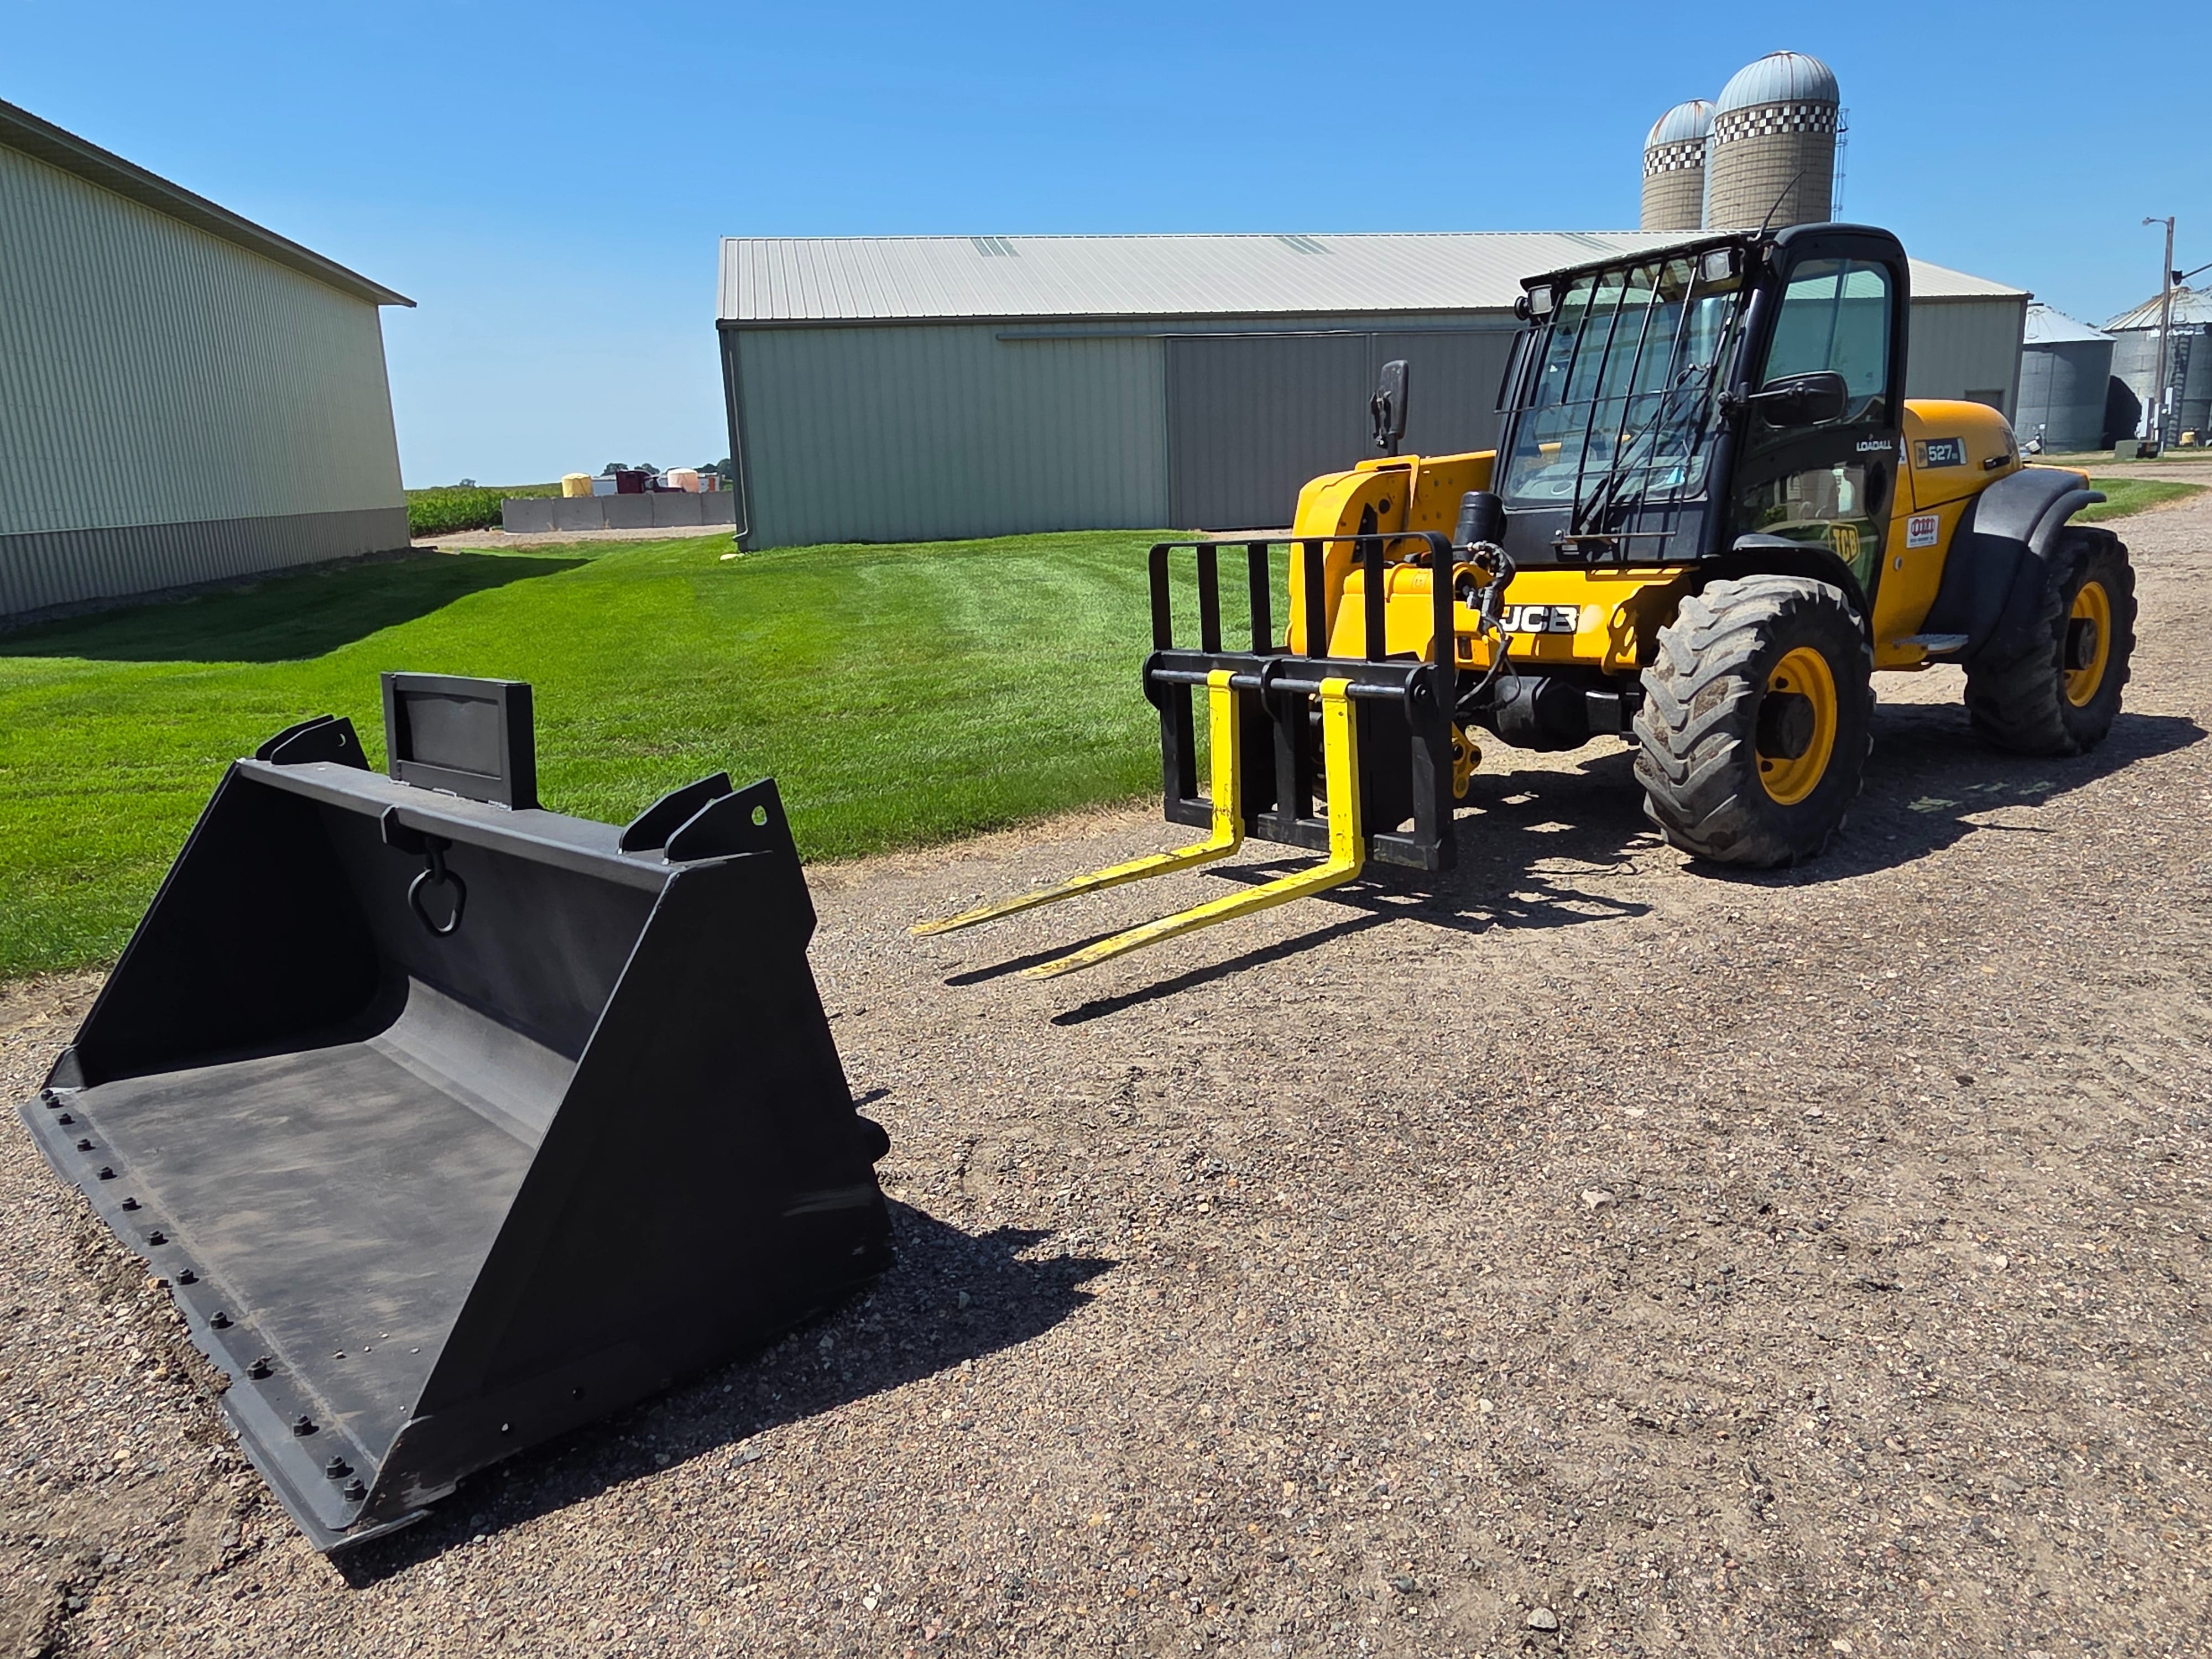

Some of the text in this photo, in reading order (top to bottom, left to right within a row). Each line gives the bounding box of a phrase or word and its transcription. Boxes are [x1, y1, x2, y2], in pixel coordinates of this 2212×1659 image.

[1856, 440, 1892, 451] LOADALL
[1928, 445, 1952, 461] 527
[1833, 529, 1857, 562] JCB
[1499, 606, 1577, 632] JCB
